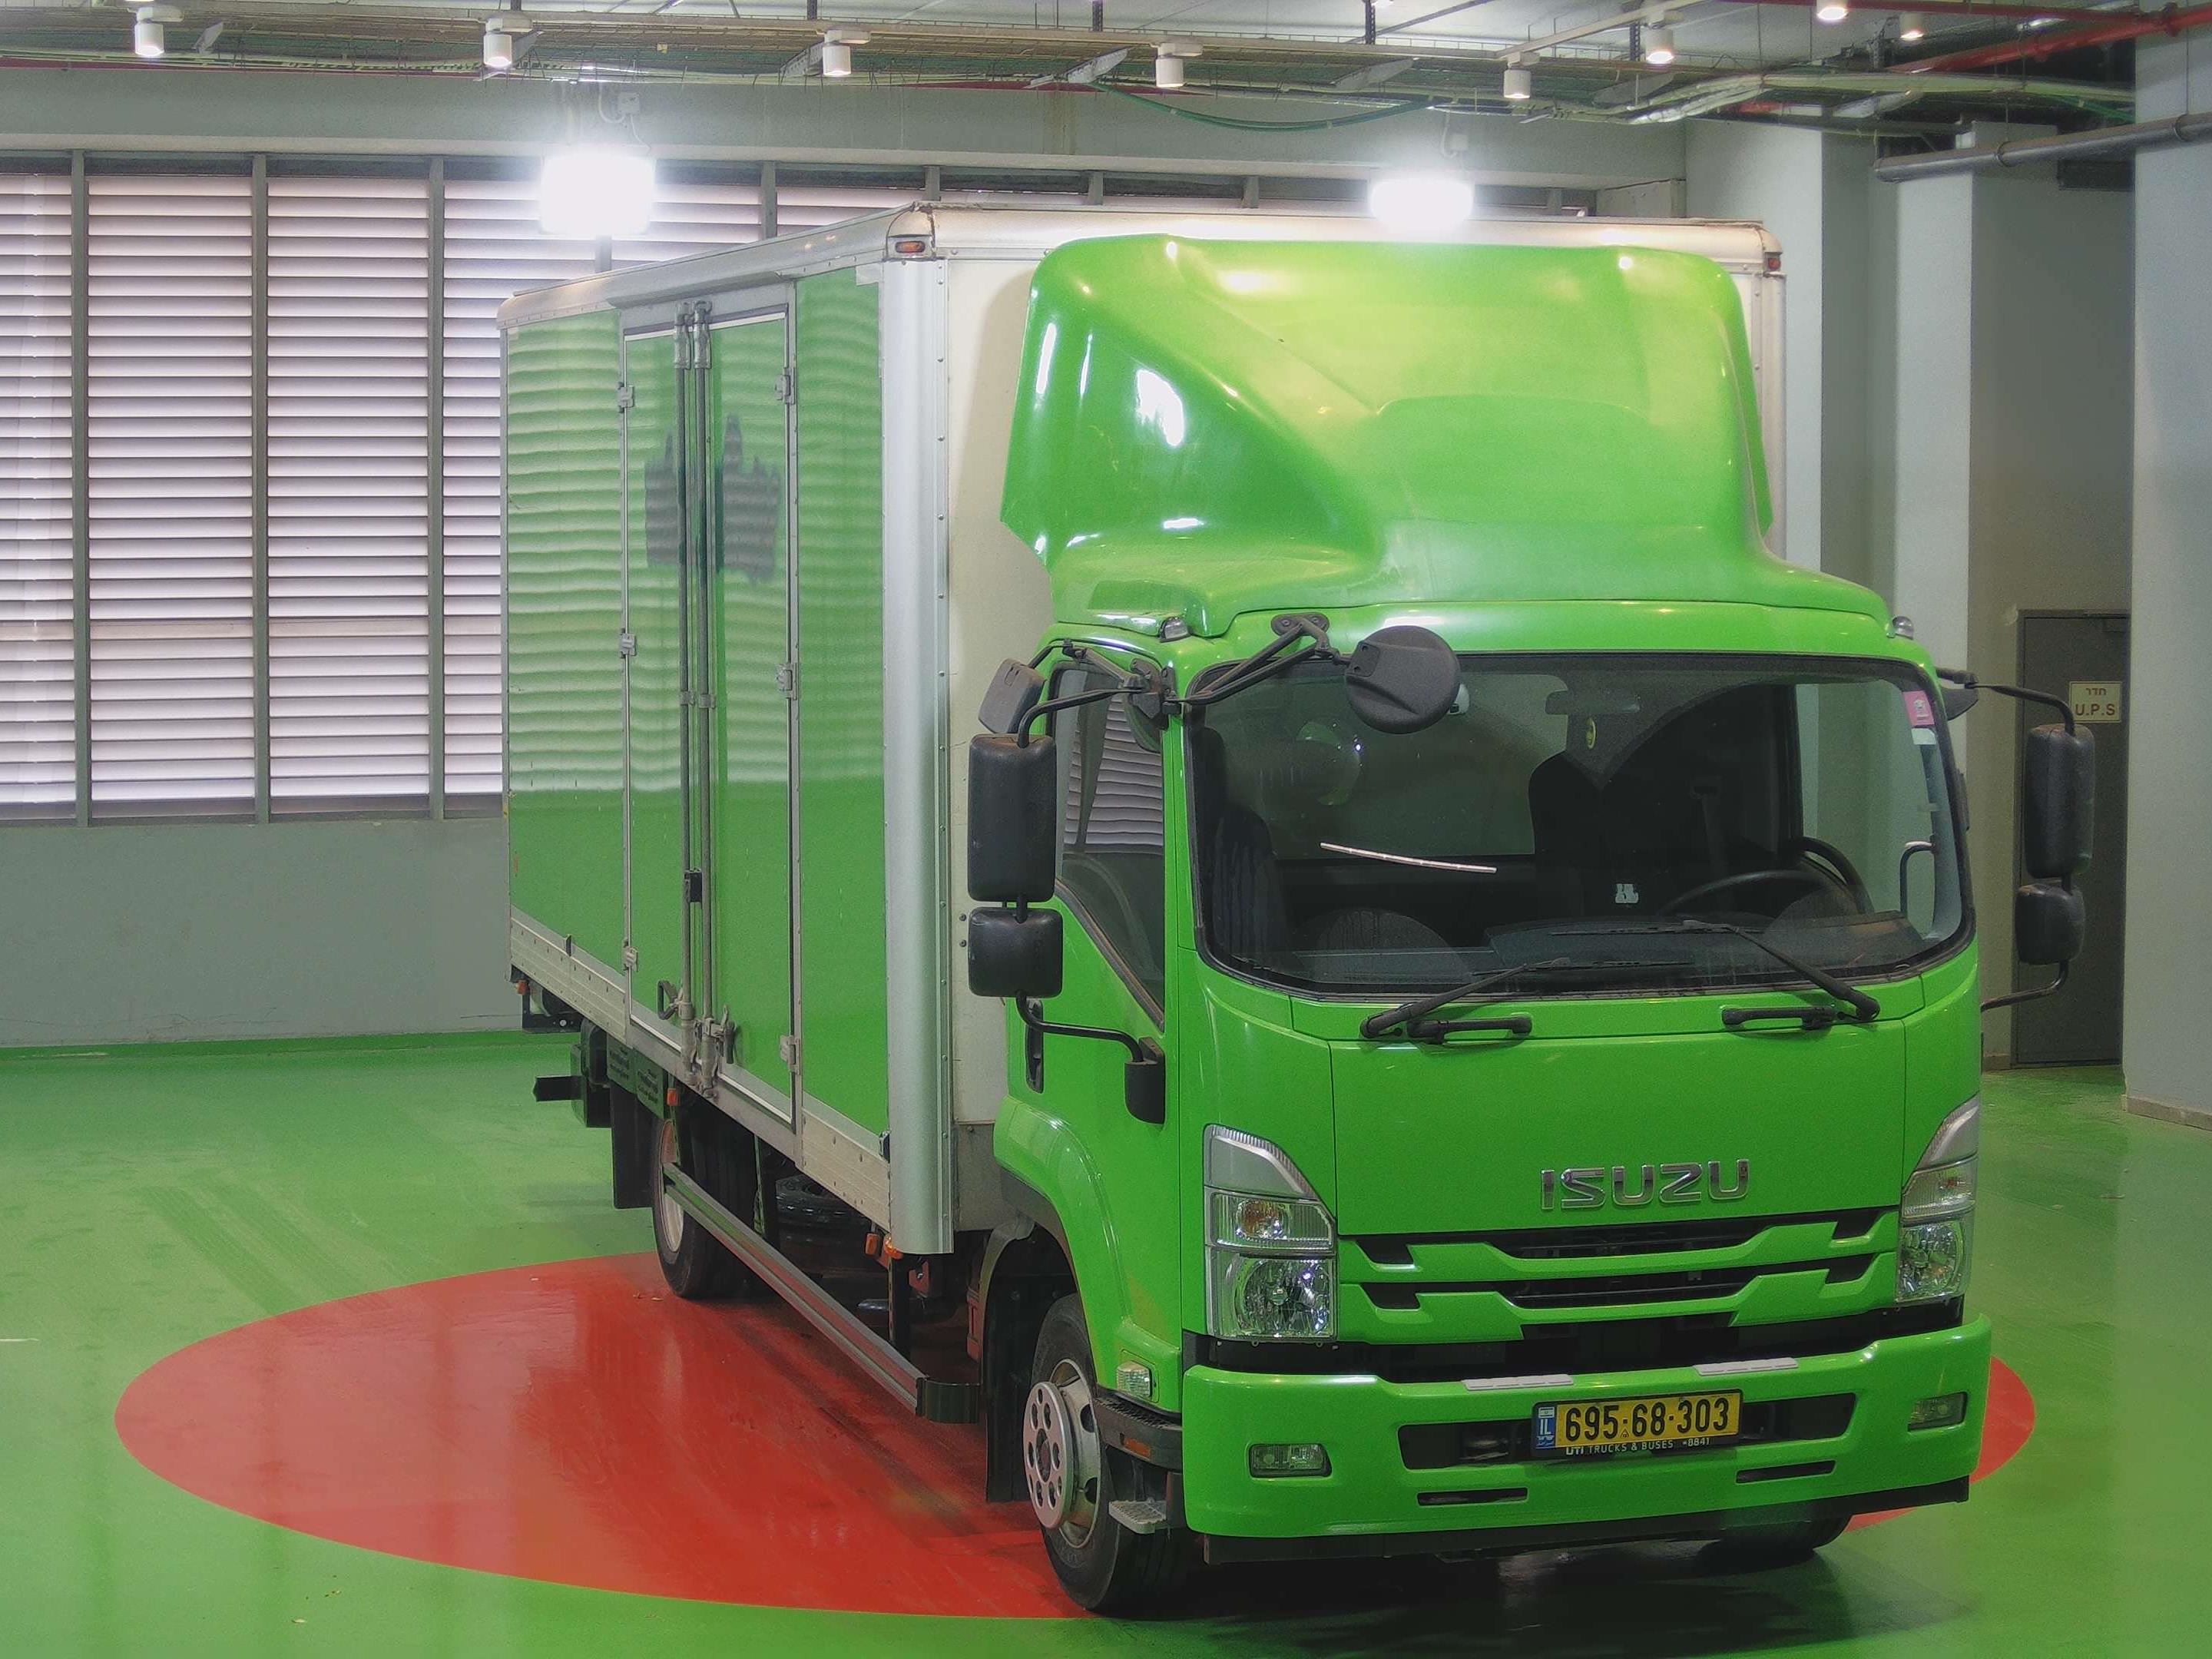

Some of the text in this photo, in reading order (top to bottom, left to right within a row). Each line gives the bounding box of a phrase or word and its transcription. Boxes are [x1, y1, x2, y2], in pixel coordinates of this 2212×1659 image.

[2085, 687, 2107, 696] חדר
[2075, 703, 2116, 716] U.P.S
[1541, 1159, 1750, 1210] ISUZU
[1539, 1418, 1551, 1435] IL
[1588, 1443, 1627, 1454] TRUCKS
[1631, 1442, 1637, 1451] &
[1641, 1439, 1674, 1450] BUSES
